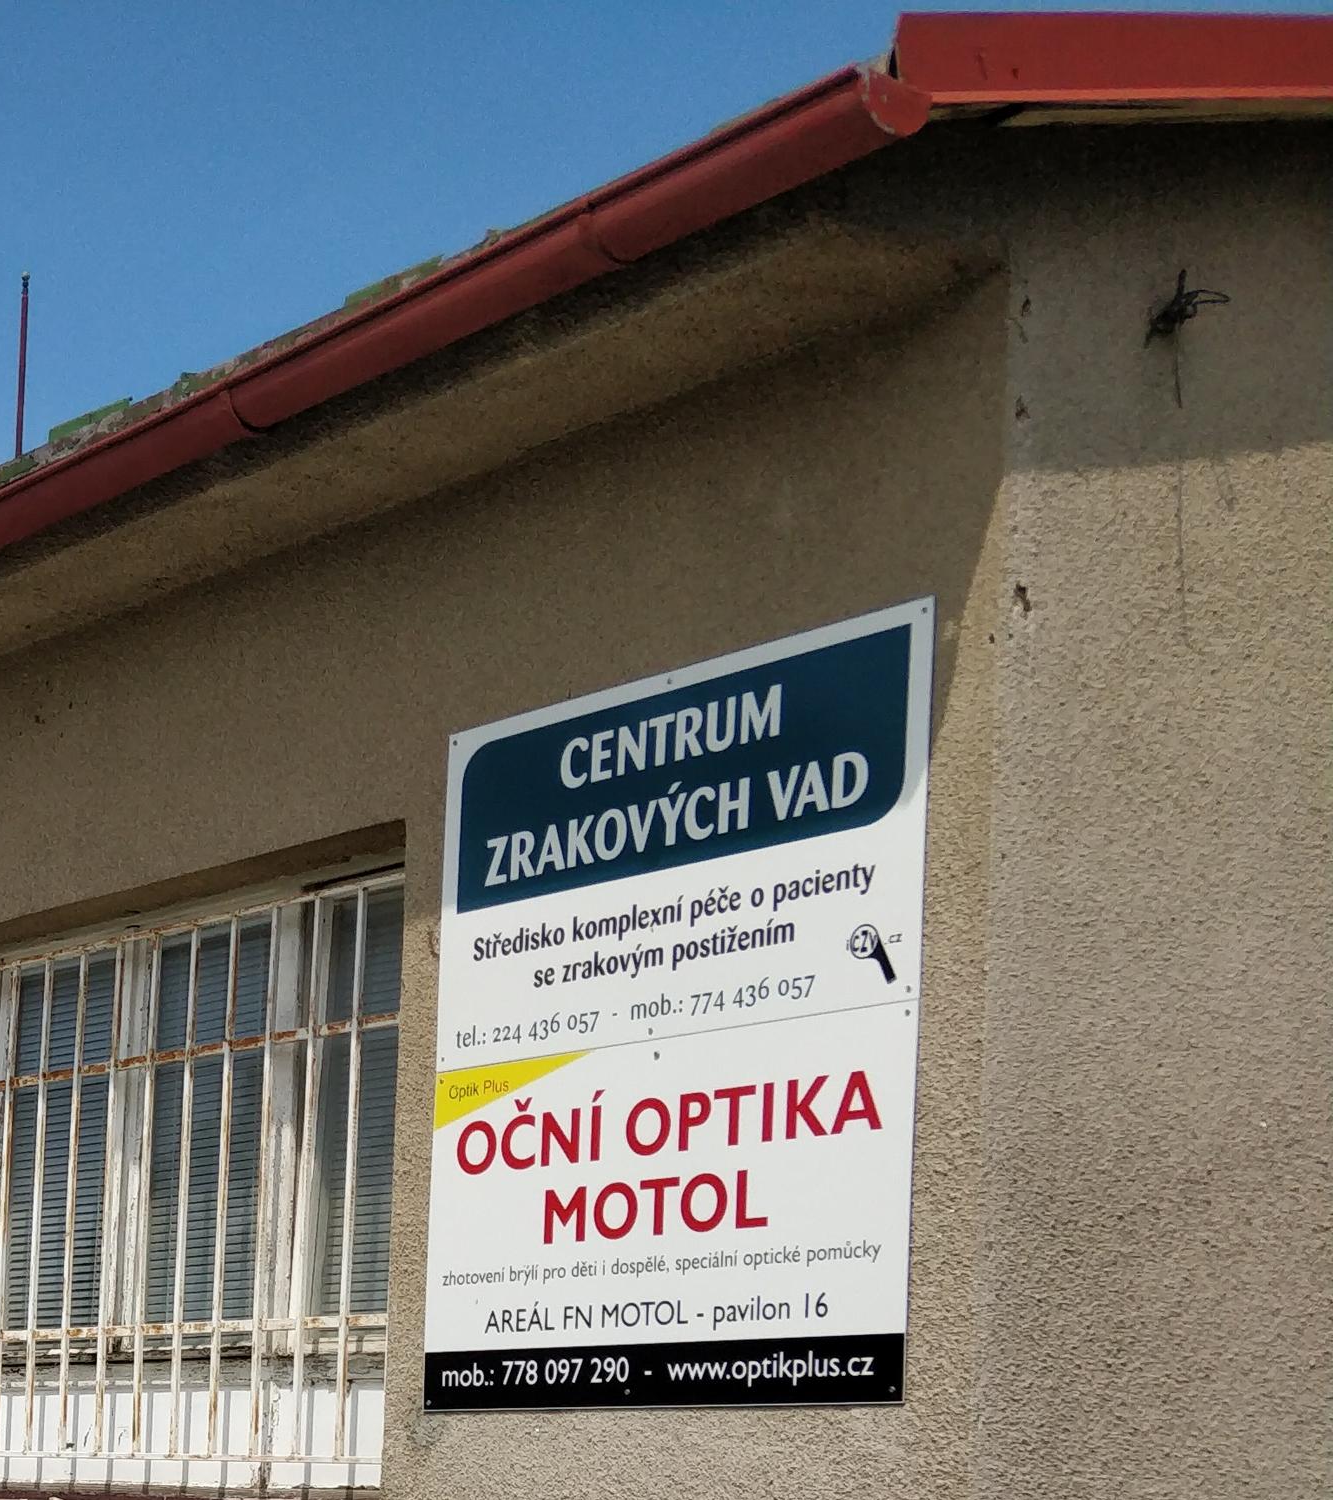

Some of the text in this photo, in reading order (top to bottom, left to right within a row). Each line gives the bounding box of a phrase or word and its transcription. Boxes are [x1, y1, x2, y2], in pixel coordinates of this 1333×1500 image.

[560, 684, 782, 789] CENTRUM
[484, 751, 869, 888] ZRAKOVÝCH VAD
[473, 864, 876, 961] Středisko komplexní péče o pacienty
[534, 919, 795, 988] se zrakovým postižením
[456, 1025, 486, 1048] tel.:
[493, 1024, 521, 1043] 224
[528, 1012, 560, 1042] 436
[567, 1011, 600, 1034] 057
[630, 993, 683, 1020] mob.:
[691, 990, 725, 1016] 774
[733, 976, 770, 1008] 436
[778, 974, 816, 1000] 057
[449, 1079, 509, 1102] Optik Plus
[457, 1070, 883, 1175] OČNÍ OPTIKA
[543, 1169, 768, 1244] MOTOL
[442, 1267, 504, 1286] zhotovení
[509, 1264, 538, 1285] brýlí
[543, 1268, 566, 1284] pro
[571, 1261, 597, 1278] děti
[611, 1255, 669, 1279] dospělé,
[675, 1251, 737, 1275] speciální
[743, 1245, 800, 1270] optické
[806, 1240, 882, 1267] pomůcky
[485, 1301, 554, 1334] AREÁL
[564, 1305, 592, 1329] FN
[601, 1300, 688, 1328] MOTOL
[713, 1296, 791, 1330] pavilon
[805, 1292, 828, 1318] 16
[441, 1363, 494, 1387] mob.:
[502, 1359, 538, 1385] 778
[545, 1358, 583, 1384] 097
[590, 1357, 629, 1384] 290
[667, 1351, 874, 1387] www.optikplus.cz
